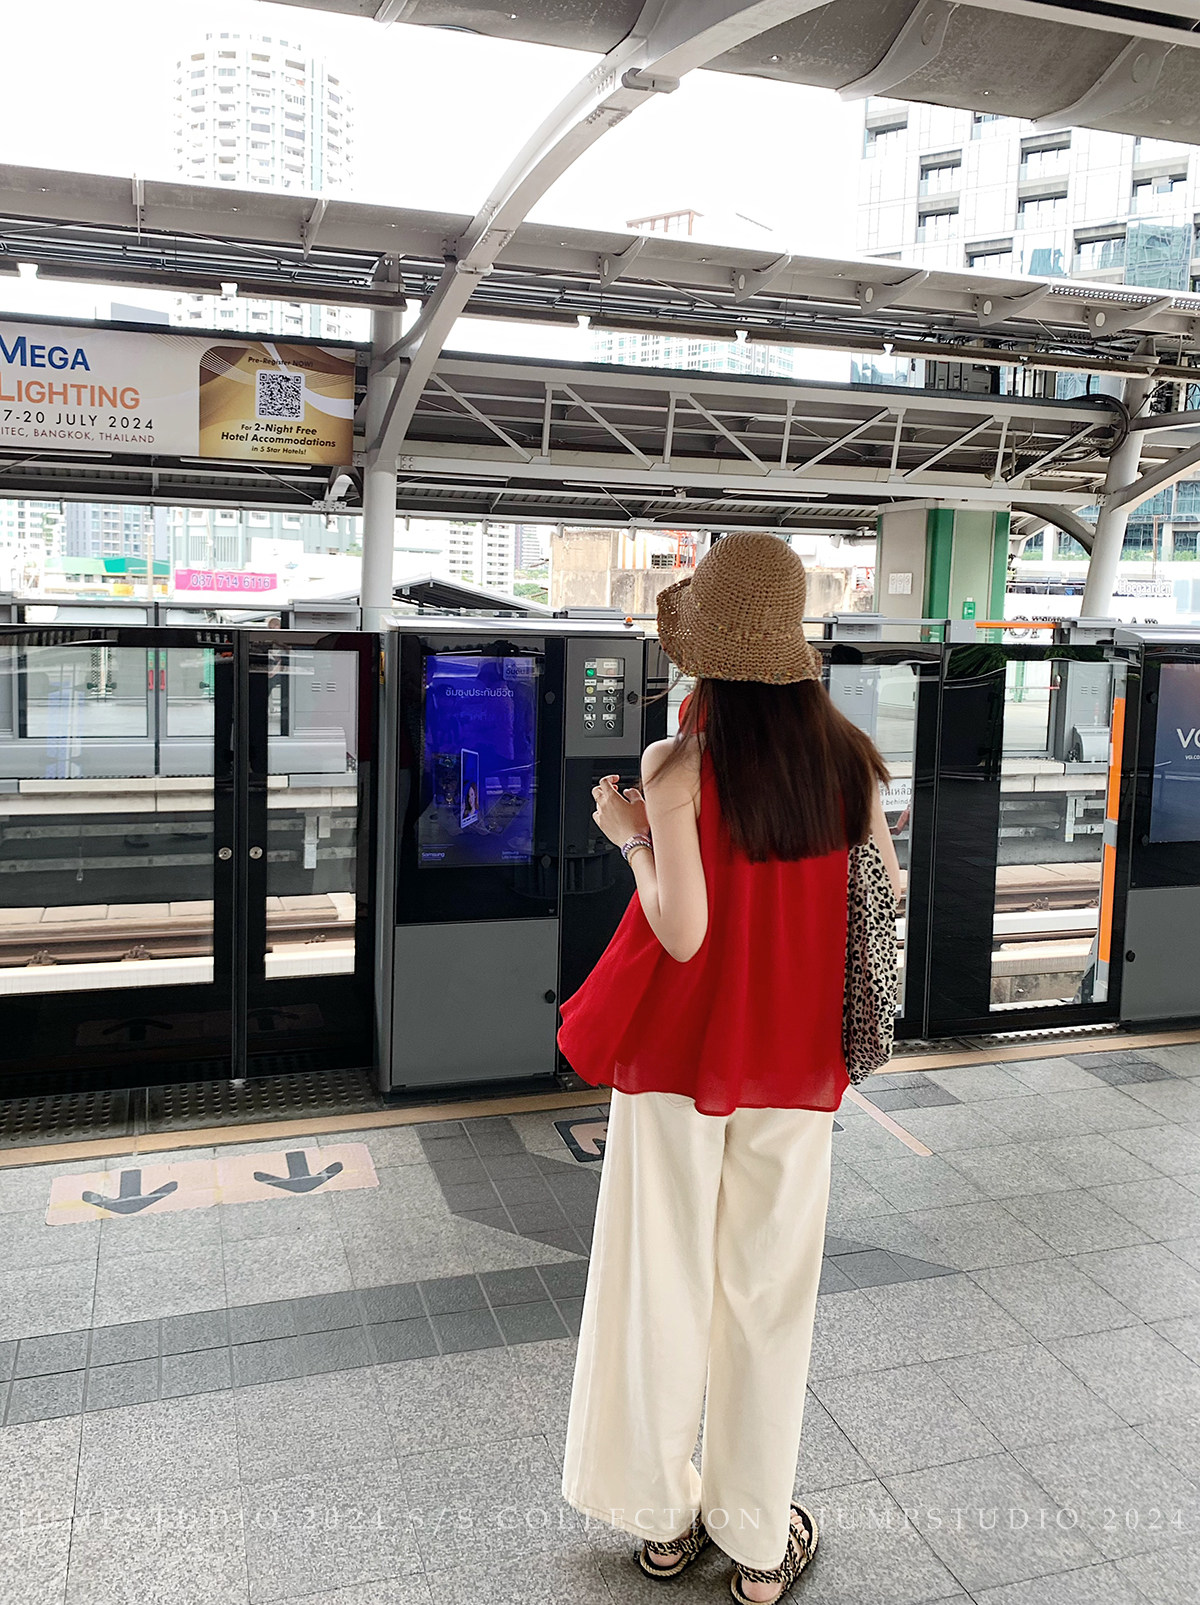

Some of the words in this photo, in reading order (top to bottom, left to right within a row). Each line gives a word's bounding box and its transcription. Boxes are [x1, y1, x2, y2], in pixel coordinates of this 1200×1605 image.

[0, 334, 91, 371] MEGA
[248, 357, 291, 367] Pre-Register
[0, 371, 140, 410] LIGHTING
[3, 409, 45, 423] 7-20
[55, 413, 98, 426] JULY
[108, 416, 153, 430] 2024
[33, 428, 94, 441] BANGKOK,
[99, 432, 155, 444] THAILAND
[254, 422, 293, 435] 2-Night
[296, 426, 318, 436] Free
[221, 431, 249, 442] Hotel
[251, 434, 336, 448] Accommodations
[282, 447, 307, 455] Hotels!
[191, 574, 212, 587] 087
[218, 575, 239, 587] 714
[243, 576, 270, 588] 6116
[1118, 579, 1171, 596] Hoegaarden
